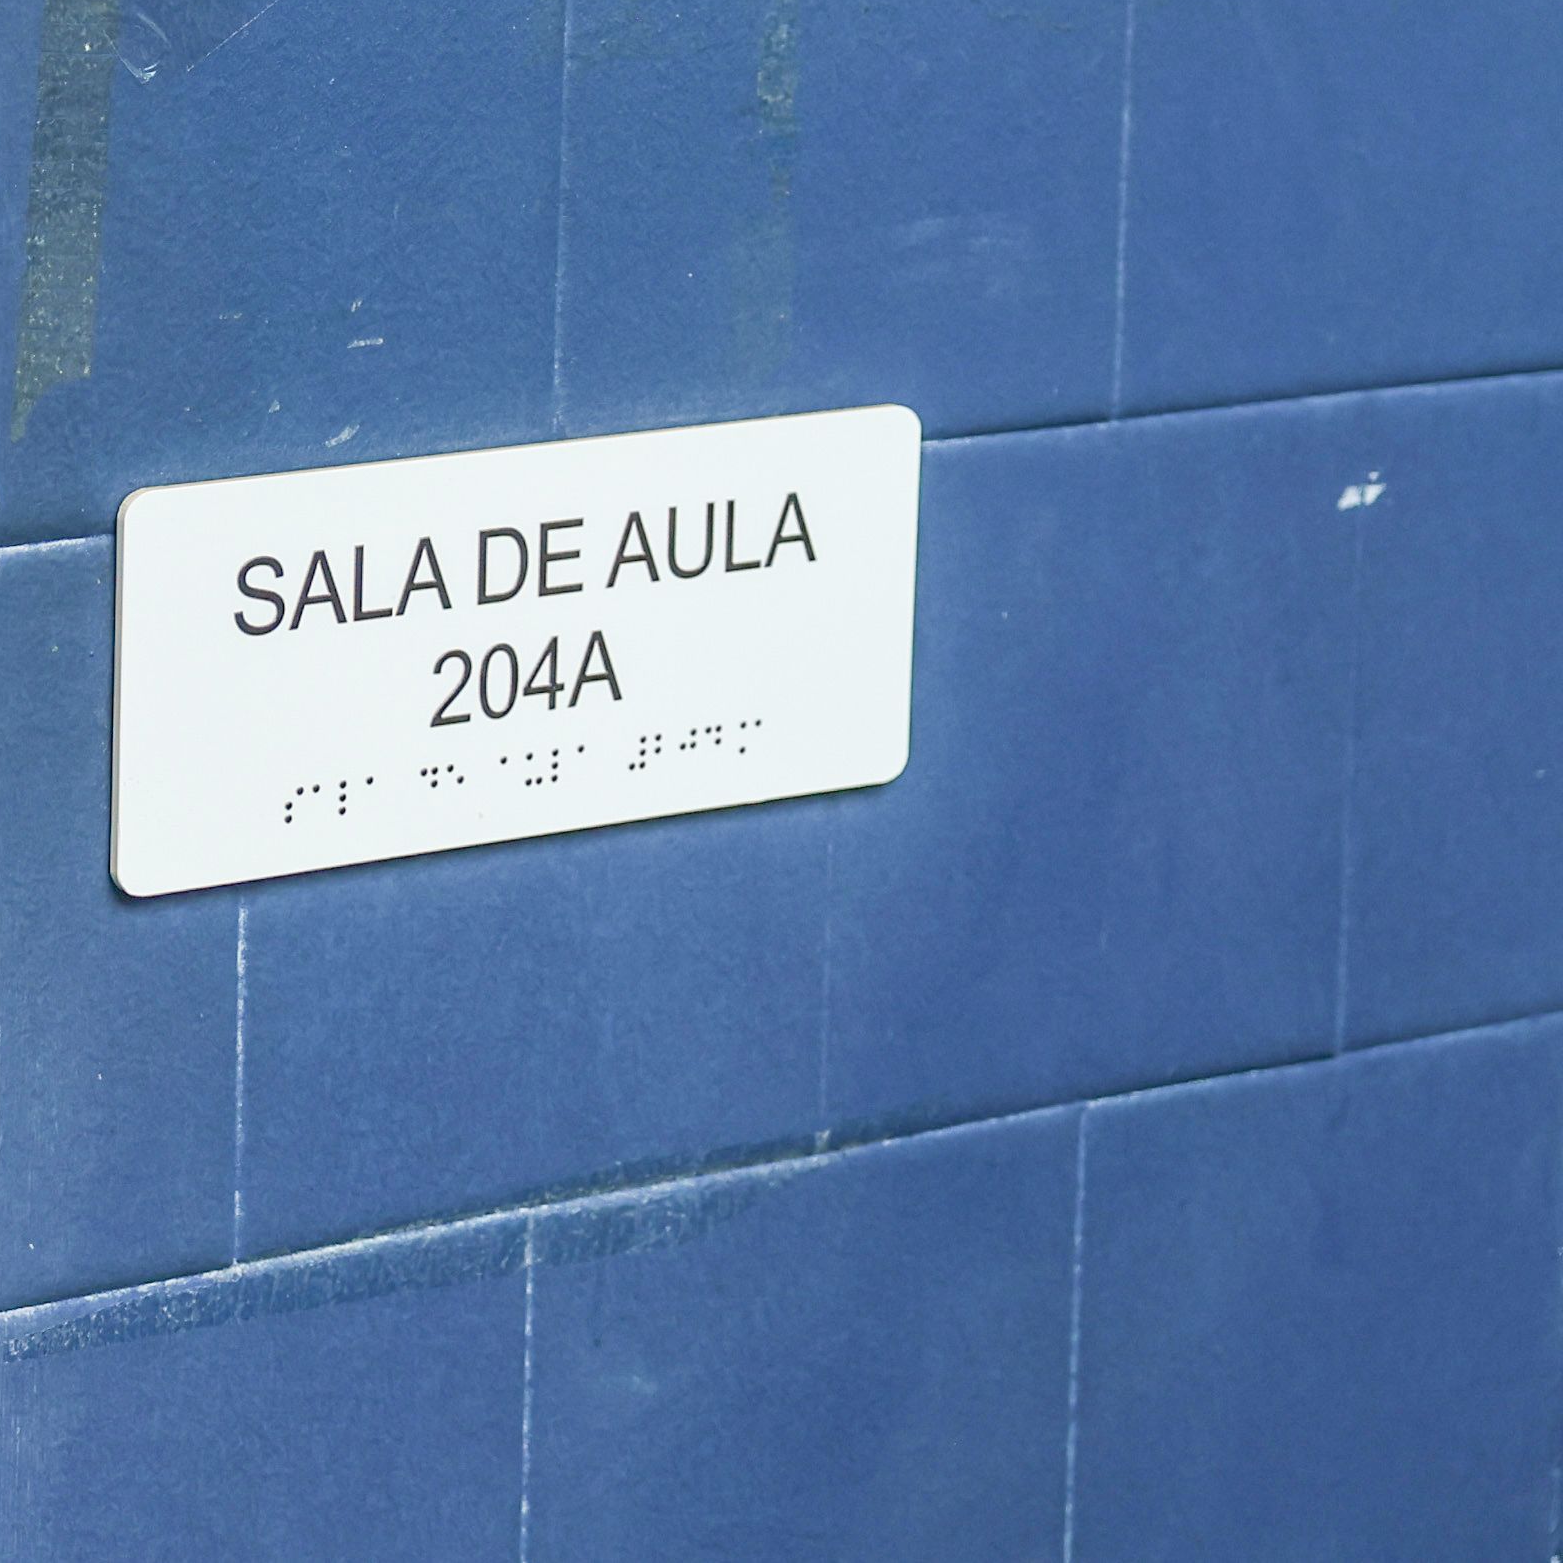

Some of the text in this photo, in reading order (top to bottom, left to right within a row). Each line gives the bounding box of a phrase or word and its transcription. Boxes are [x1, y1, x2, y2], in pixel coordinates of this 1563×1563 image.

[235, 493, 815, 635] SALA DE AULA
[431, 631, 621, 727] 204A
